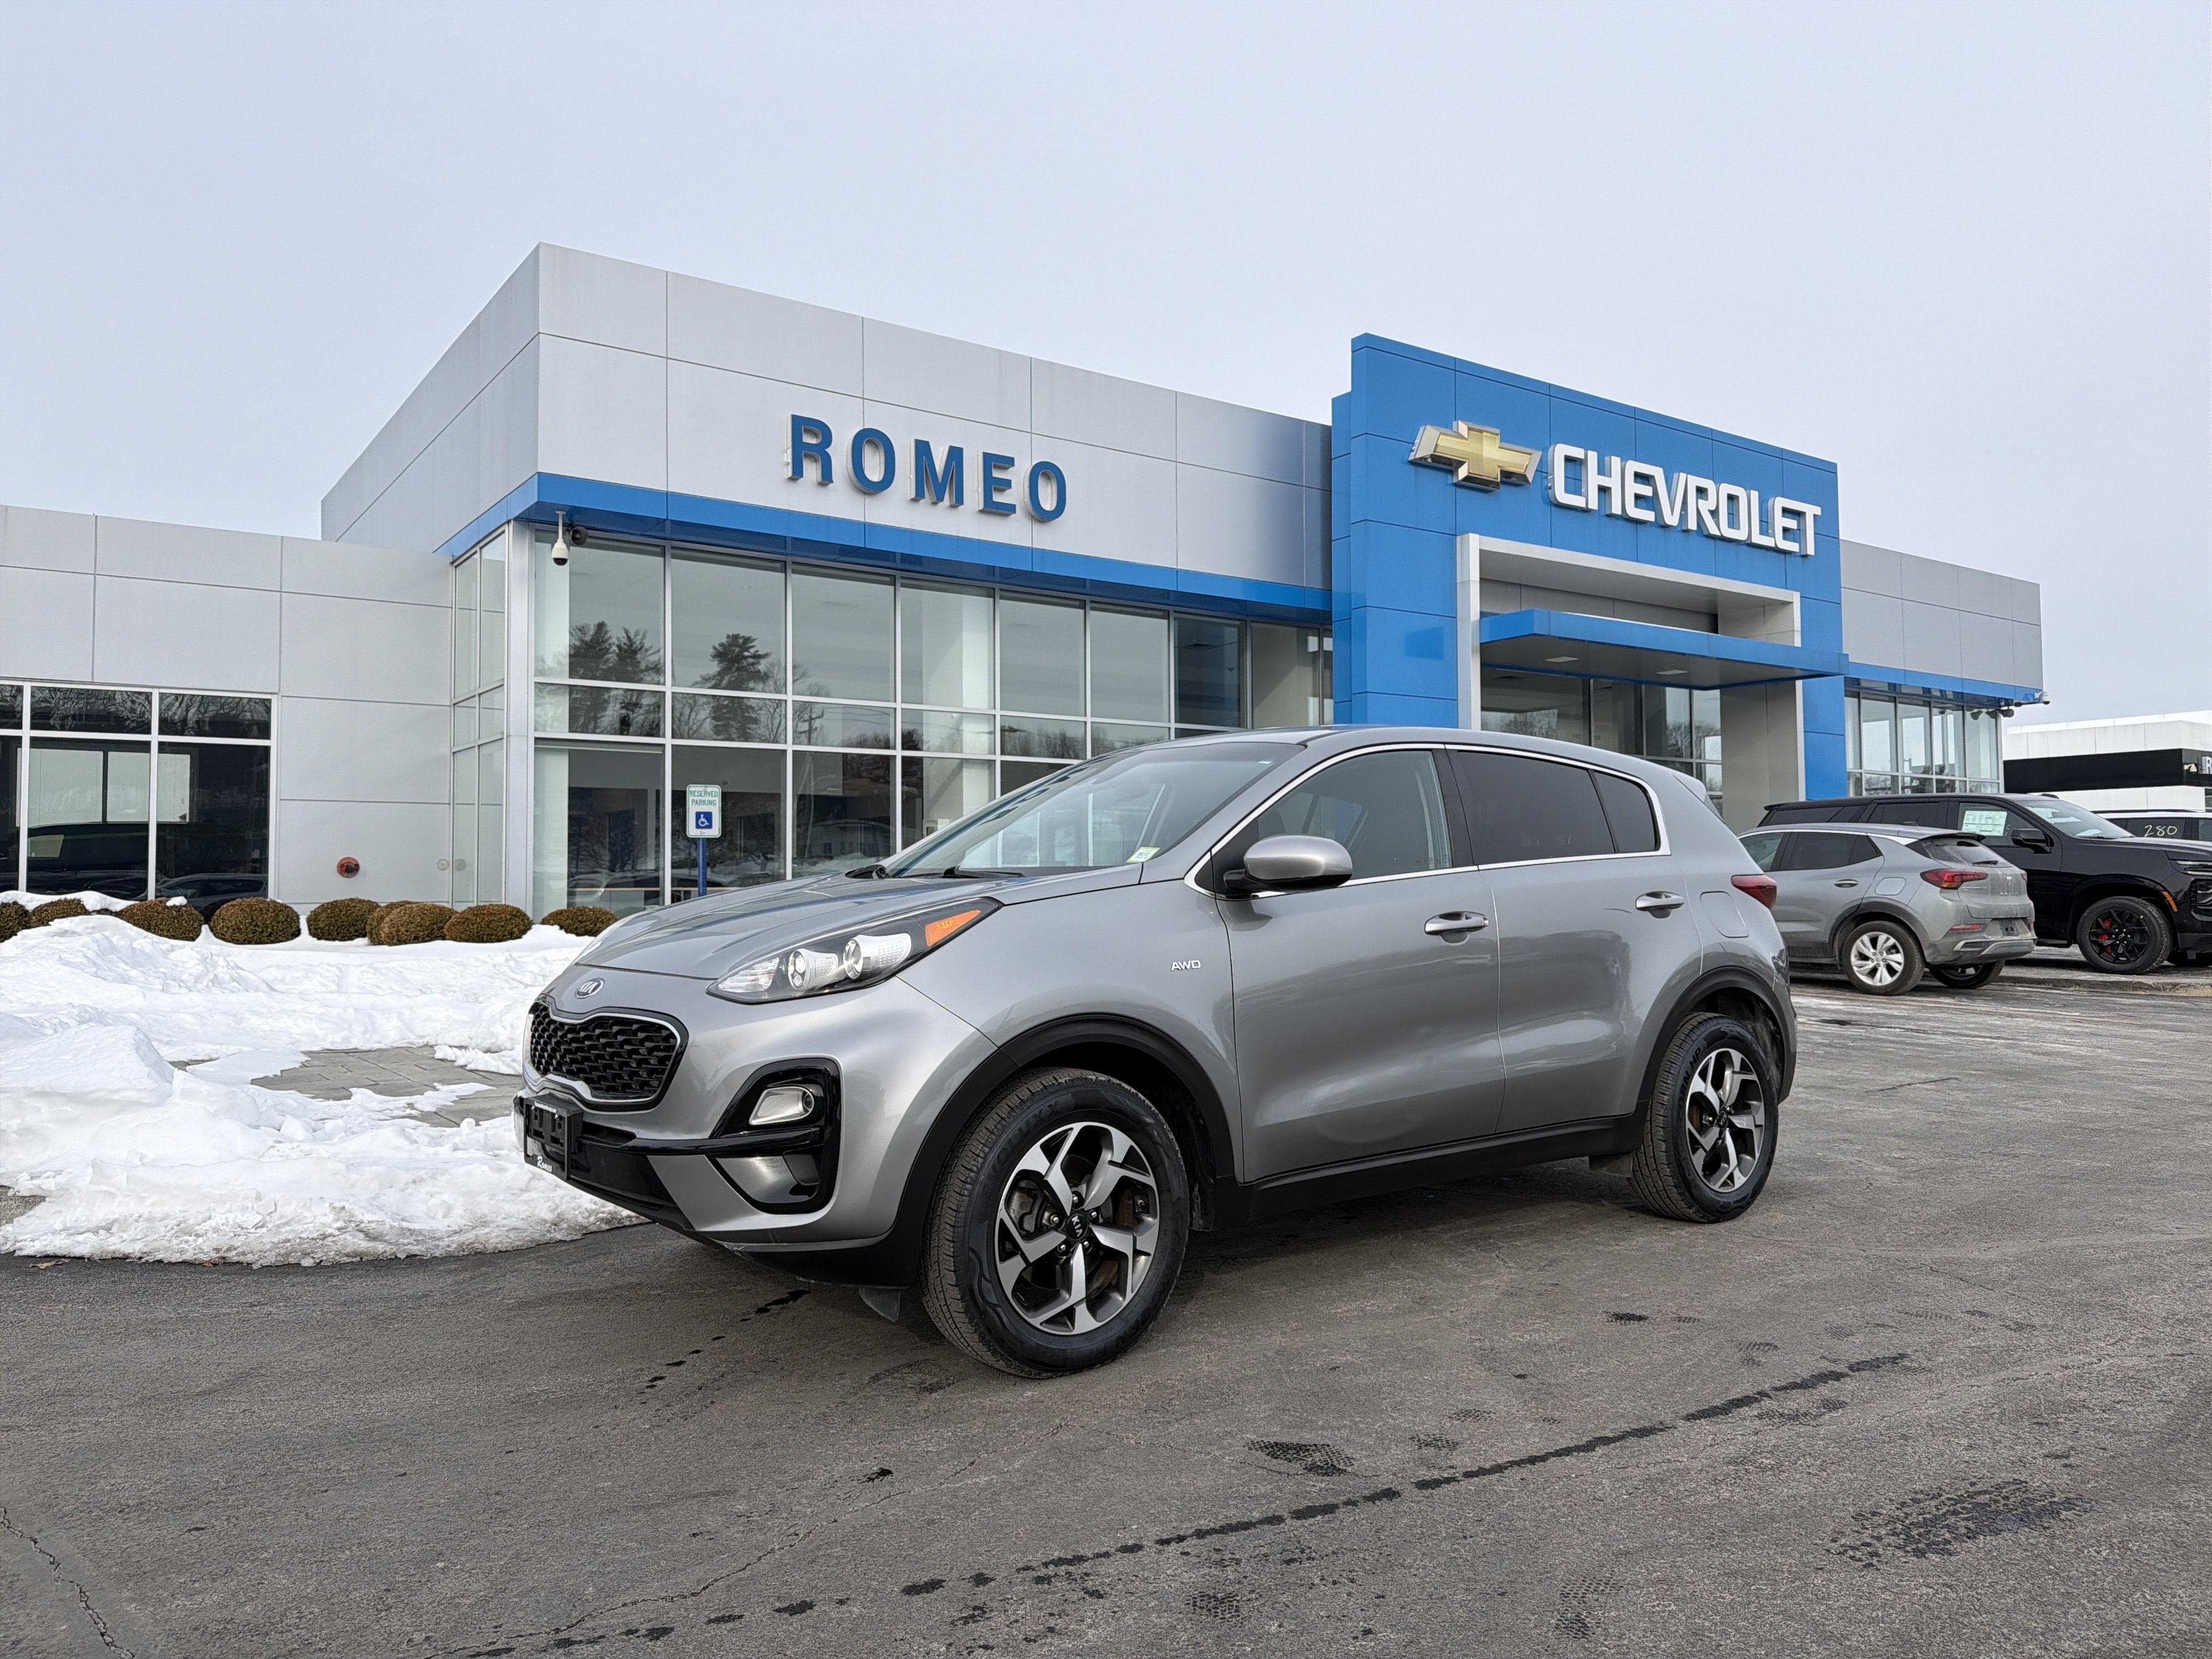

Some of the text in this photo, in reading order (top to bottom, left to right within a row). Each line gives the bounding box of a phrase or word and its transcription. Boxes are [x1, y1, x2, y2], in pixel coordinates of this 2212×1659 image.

[788, 414, 1066, 521] ROMEO
[1548, 443, 1821, 556] CHEVROLET
[2144, 825, 2177, 837] 280
[1171, 960, 1201, 971] AWD
[1071, 1215, 1083, 1238] KIA
